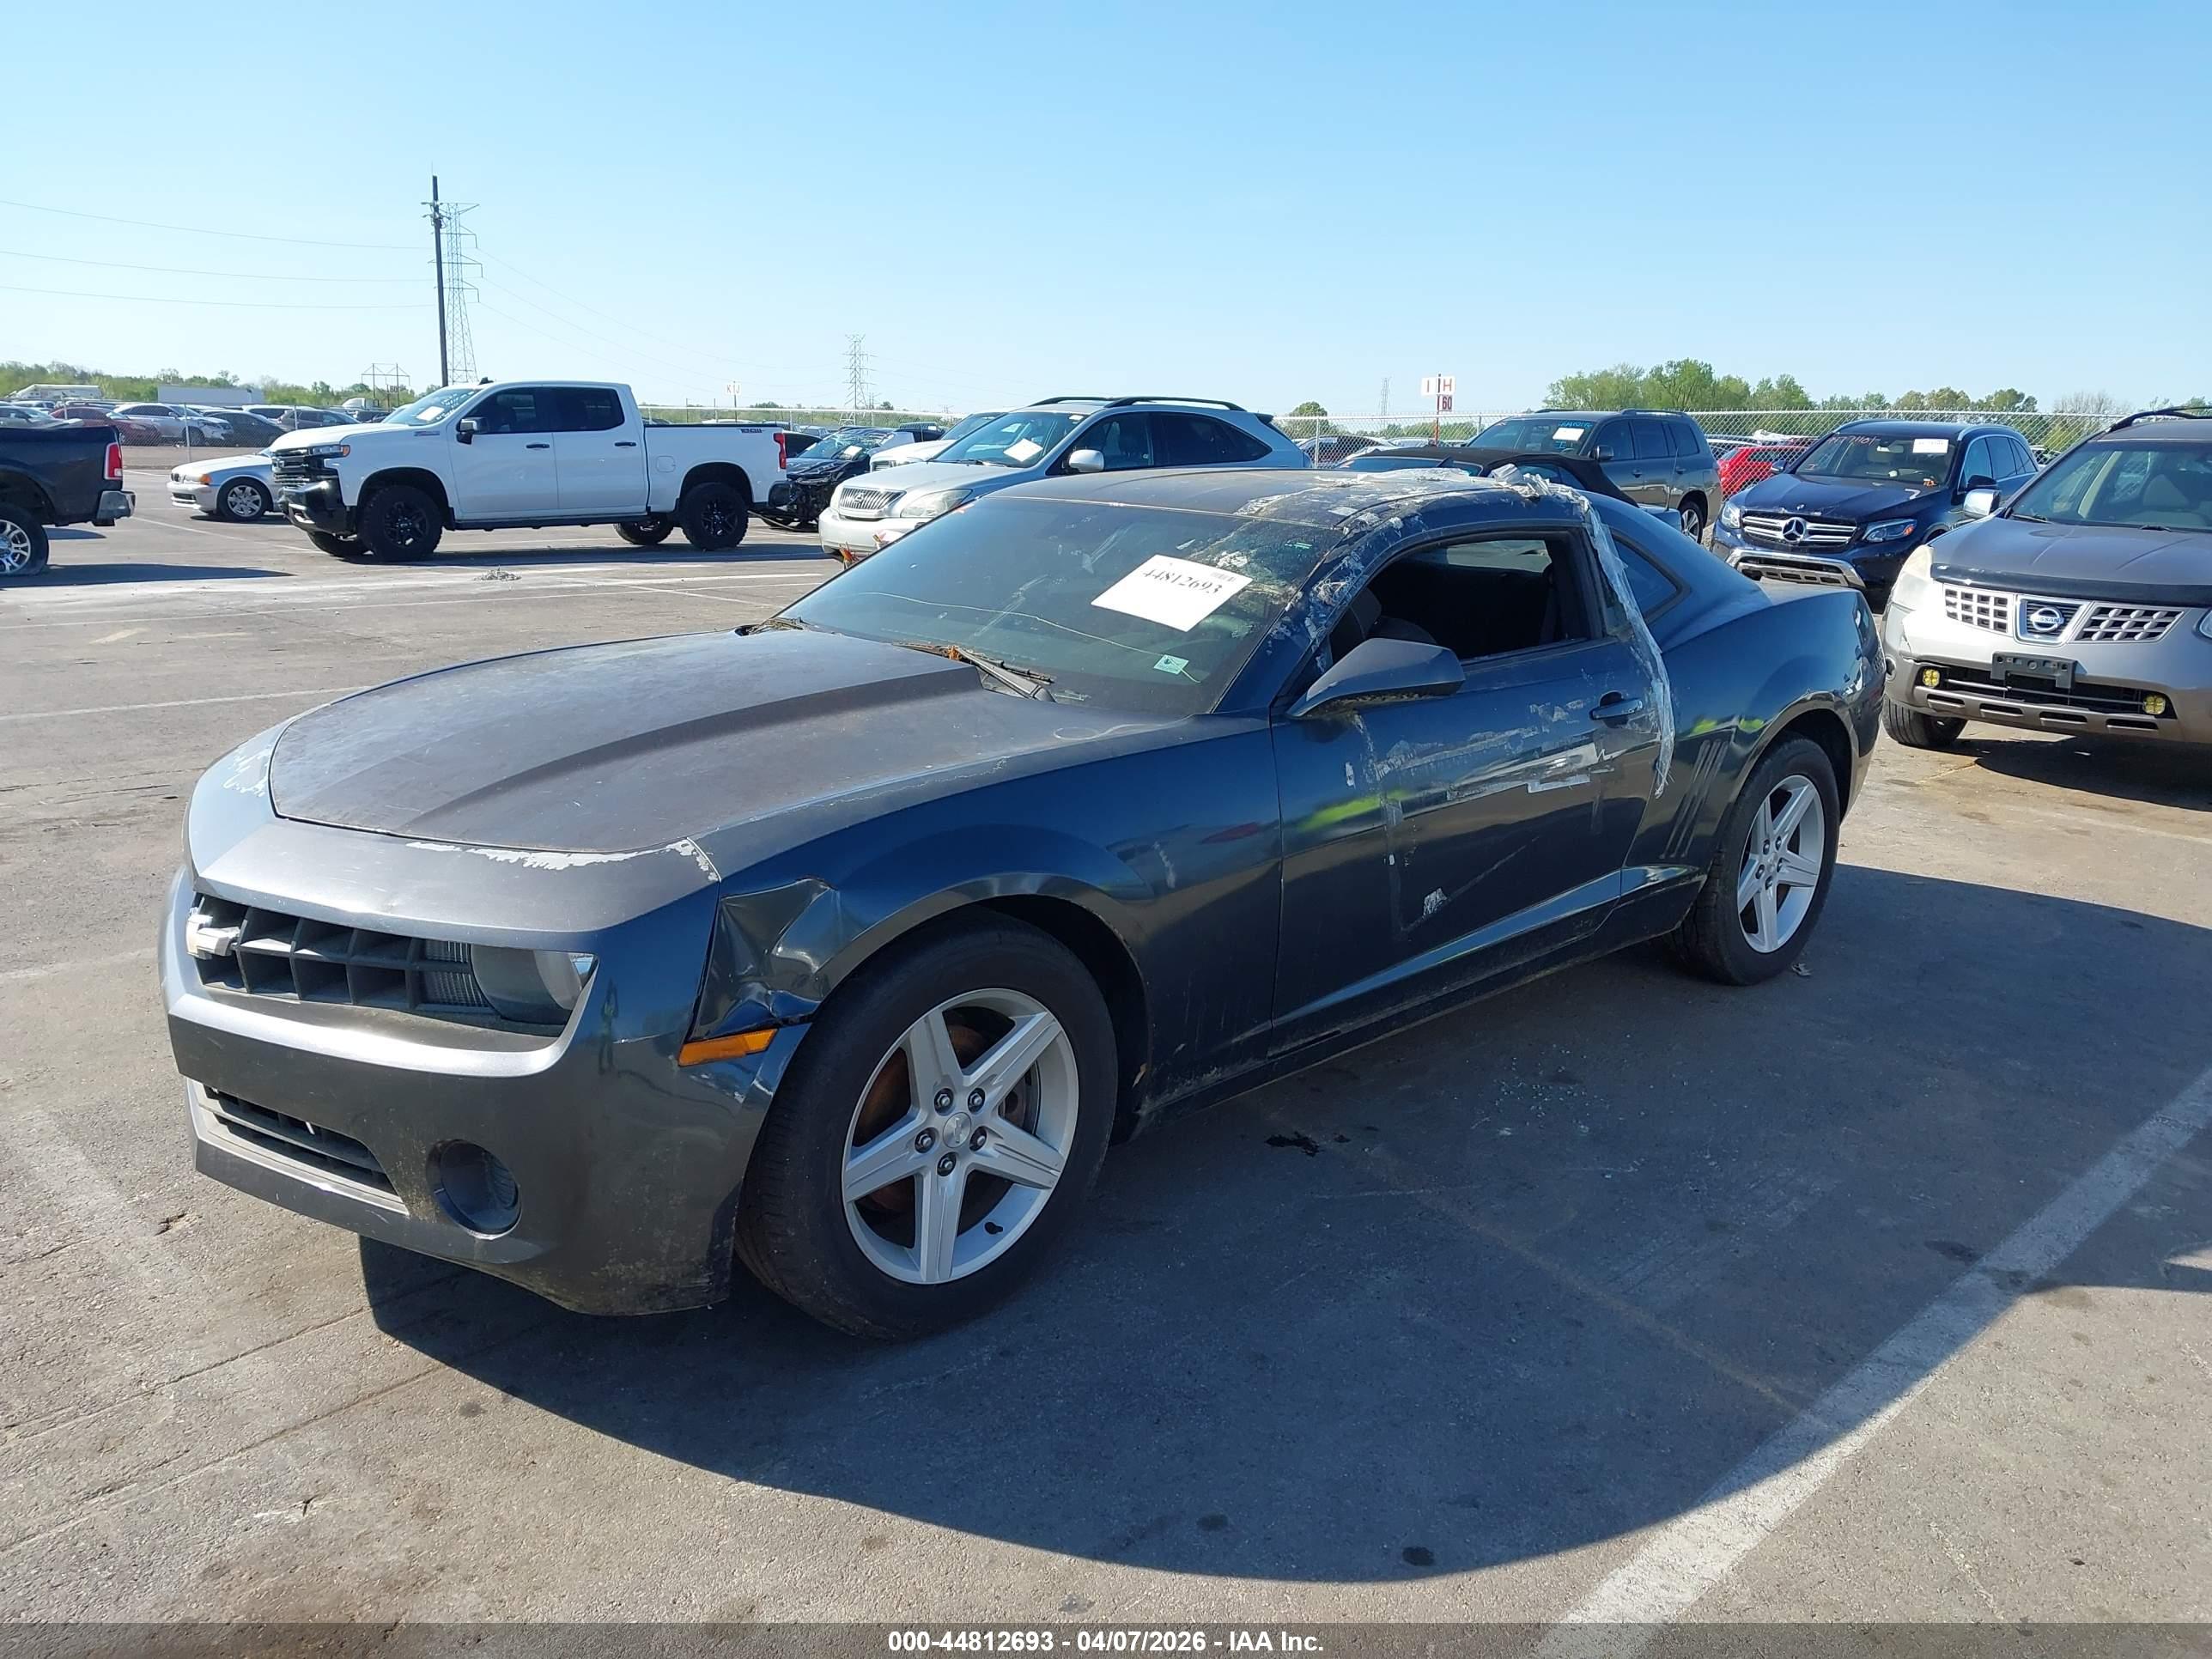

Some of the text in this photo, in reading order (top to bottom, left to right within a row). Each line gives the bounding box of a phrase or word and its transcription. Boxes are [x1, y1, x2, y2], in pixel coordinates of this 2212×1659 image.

[1443, 379, 1453, 392] H
[1442, 396, 1453, 410] 60
[1143, 568, 1223, 594] 44812693
